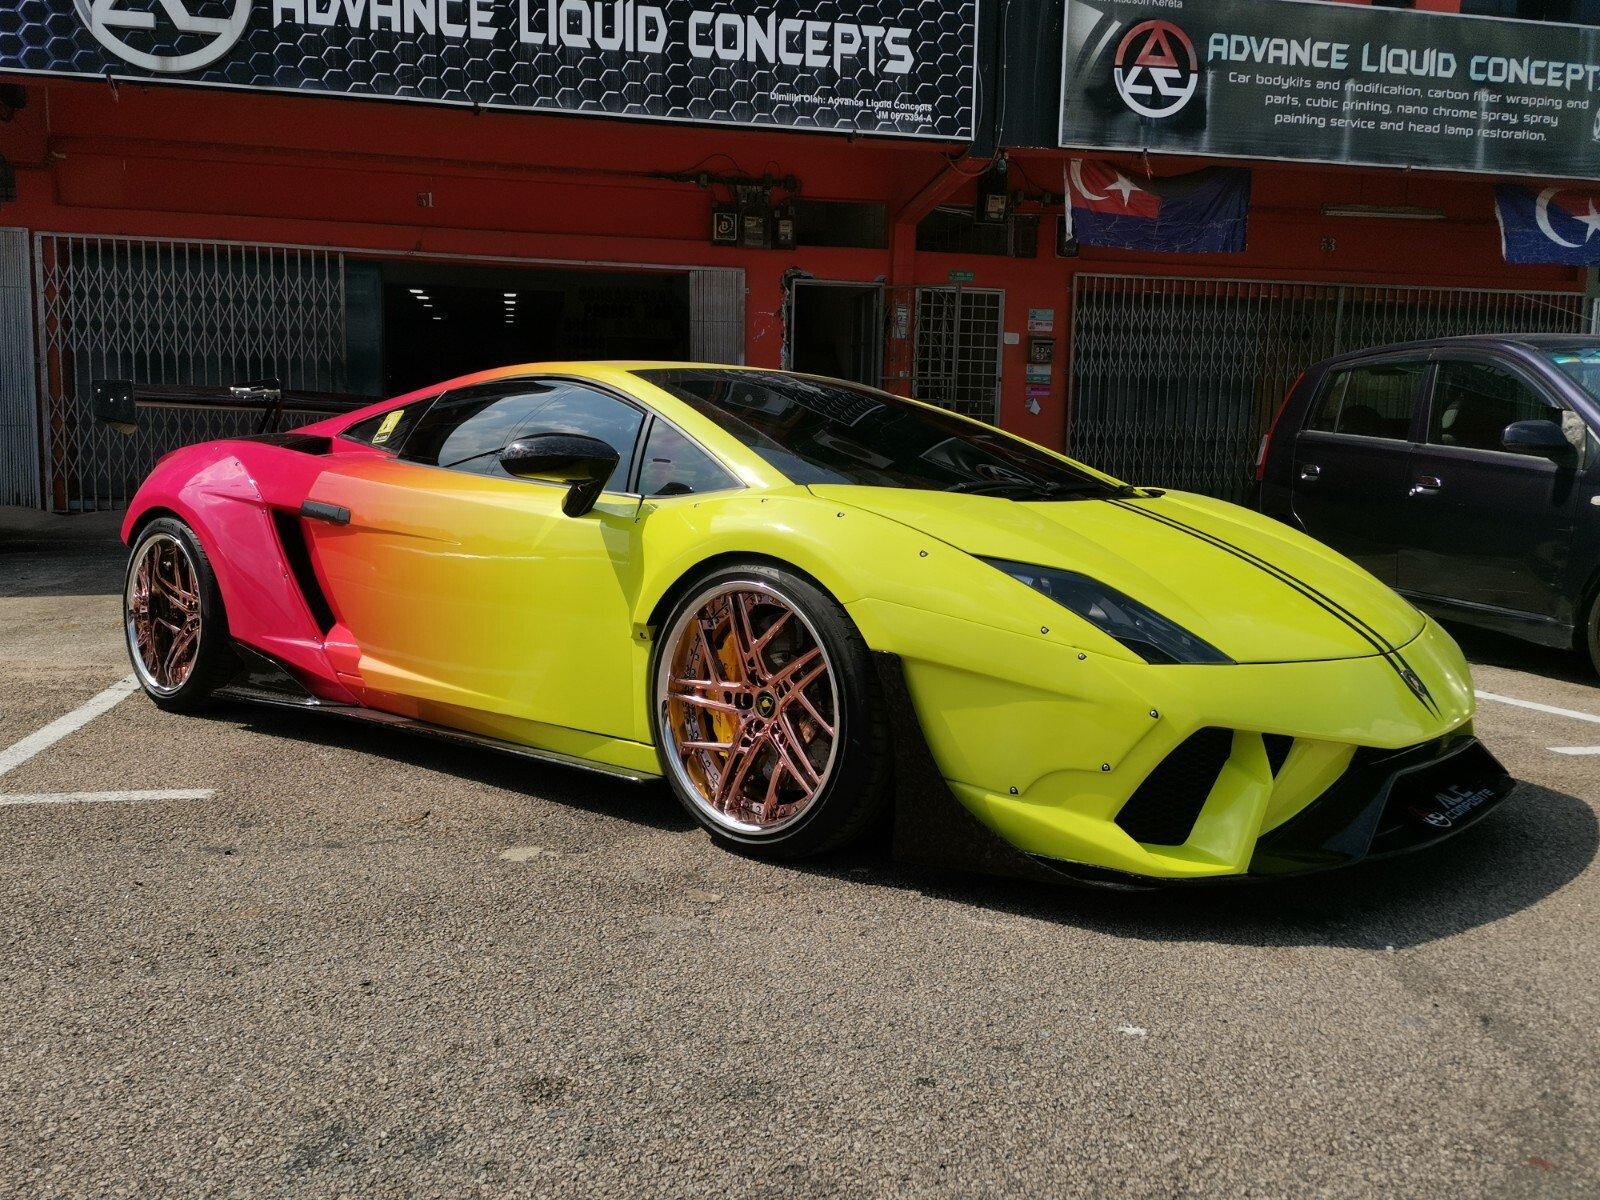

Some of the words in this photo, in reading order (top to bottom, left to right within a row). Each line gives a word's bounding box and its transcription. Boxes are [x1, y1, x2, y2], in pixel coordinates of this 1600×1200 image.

[273, 0, 499, 40] ADVANCE
[519, 0, 668, 53] LIQUID
[688, 10, 914, 77] CONCEPTS
[1207, 32, 1350, 70] ADVANCE
[1361, 42, 1458, 78] LIQUID
[1469, 55, 1600, 92] CONCEPT
[803, 94, 826, 104] Oleh:
[828, 96, 864, 107] Advance
[865, 99, 892, 110] Liquid
[893, 101, 932, 113] Concepts
[1229, 71, 1251, 83] Car
[1255, 73, 1311, 89] bodykits
[1316, 80, 1340, 91] and
[1344, 81, 1423, 99] modification,
[1427, 88, 1469, 102] carbon
[1473, 91, 1502, 103] fiber
[1506, 95, 1563, 110] wrapping
[1566, 99, 1589, 109] and
[876, 110, 889, 119] JM
[1264, 93, 1301, 107] parts,
[1305, 96, 1339, 109] cubic
[1343, 99, 1392, 115] printing,
[1397, 104, 1428, 115] nano
[1432, 106, 1478, 120] chrome
[1523, 114, 1559, 127] spray
[1274, 112, 1326, 128] painting
[1330, 117, 1376, 130] service
[1380, 119, 1404, 132] and
[1408, 121, 1440, 134] head
[1444, 123, 1474, 139] lamp
[1477, 127, 1547, 142] restoration.
[1435, 784, 1474, 809] ALC
[1445, 788, 1495, 820] COMPOSITE
